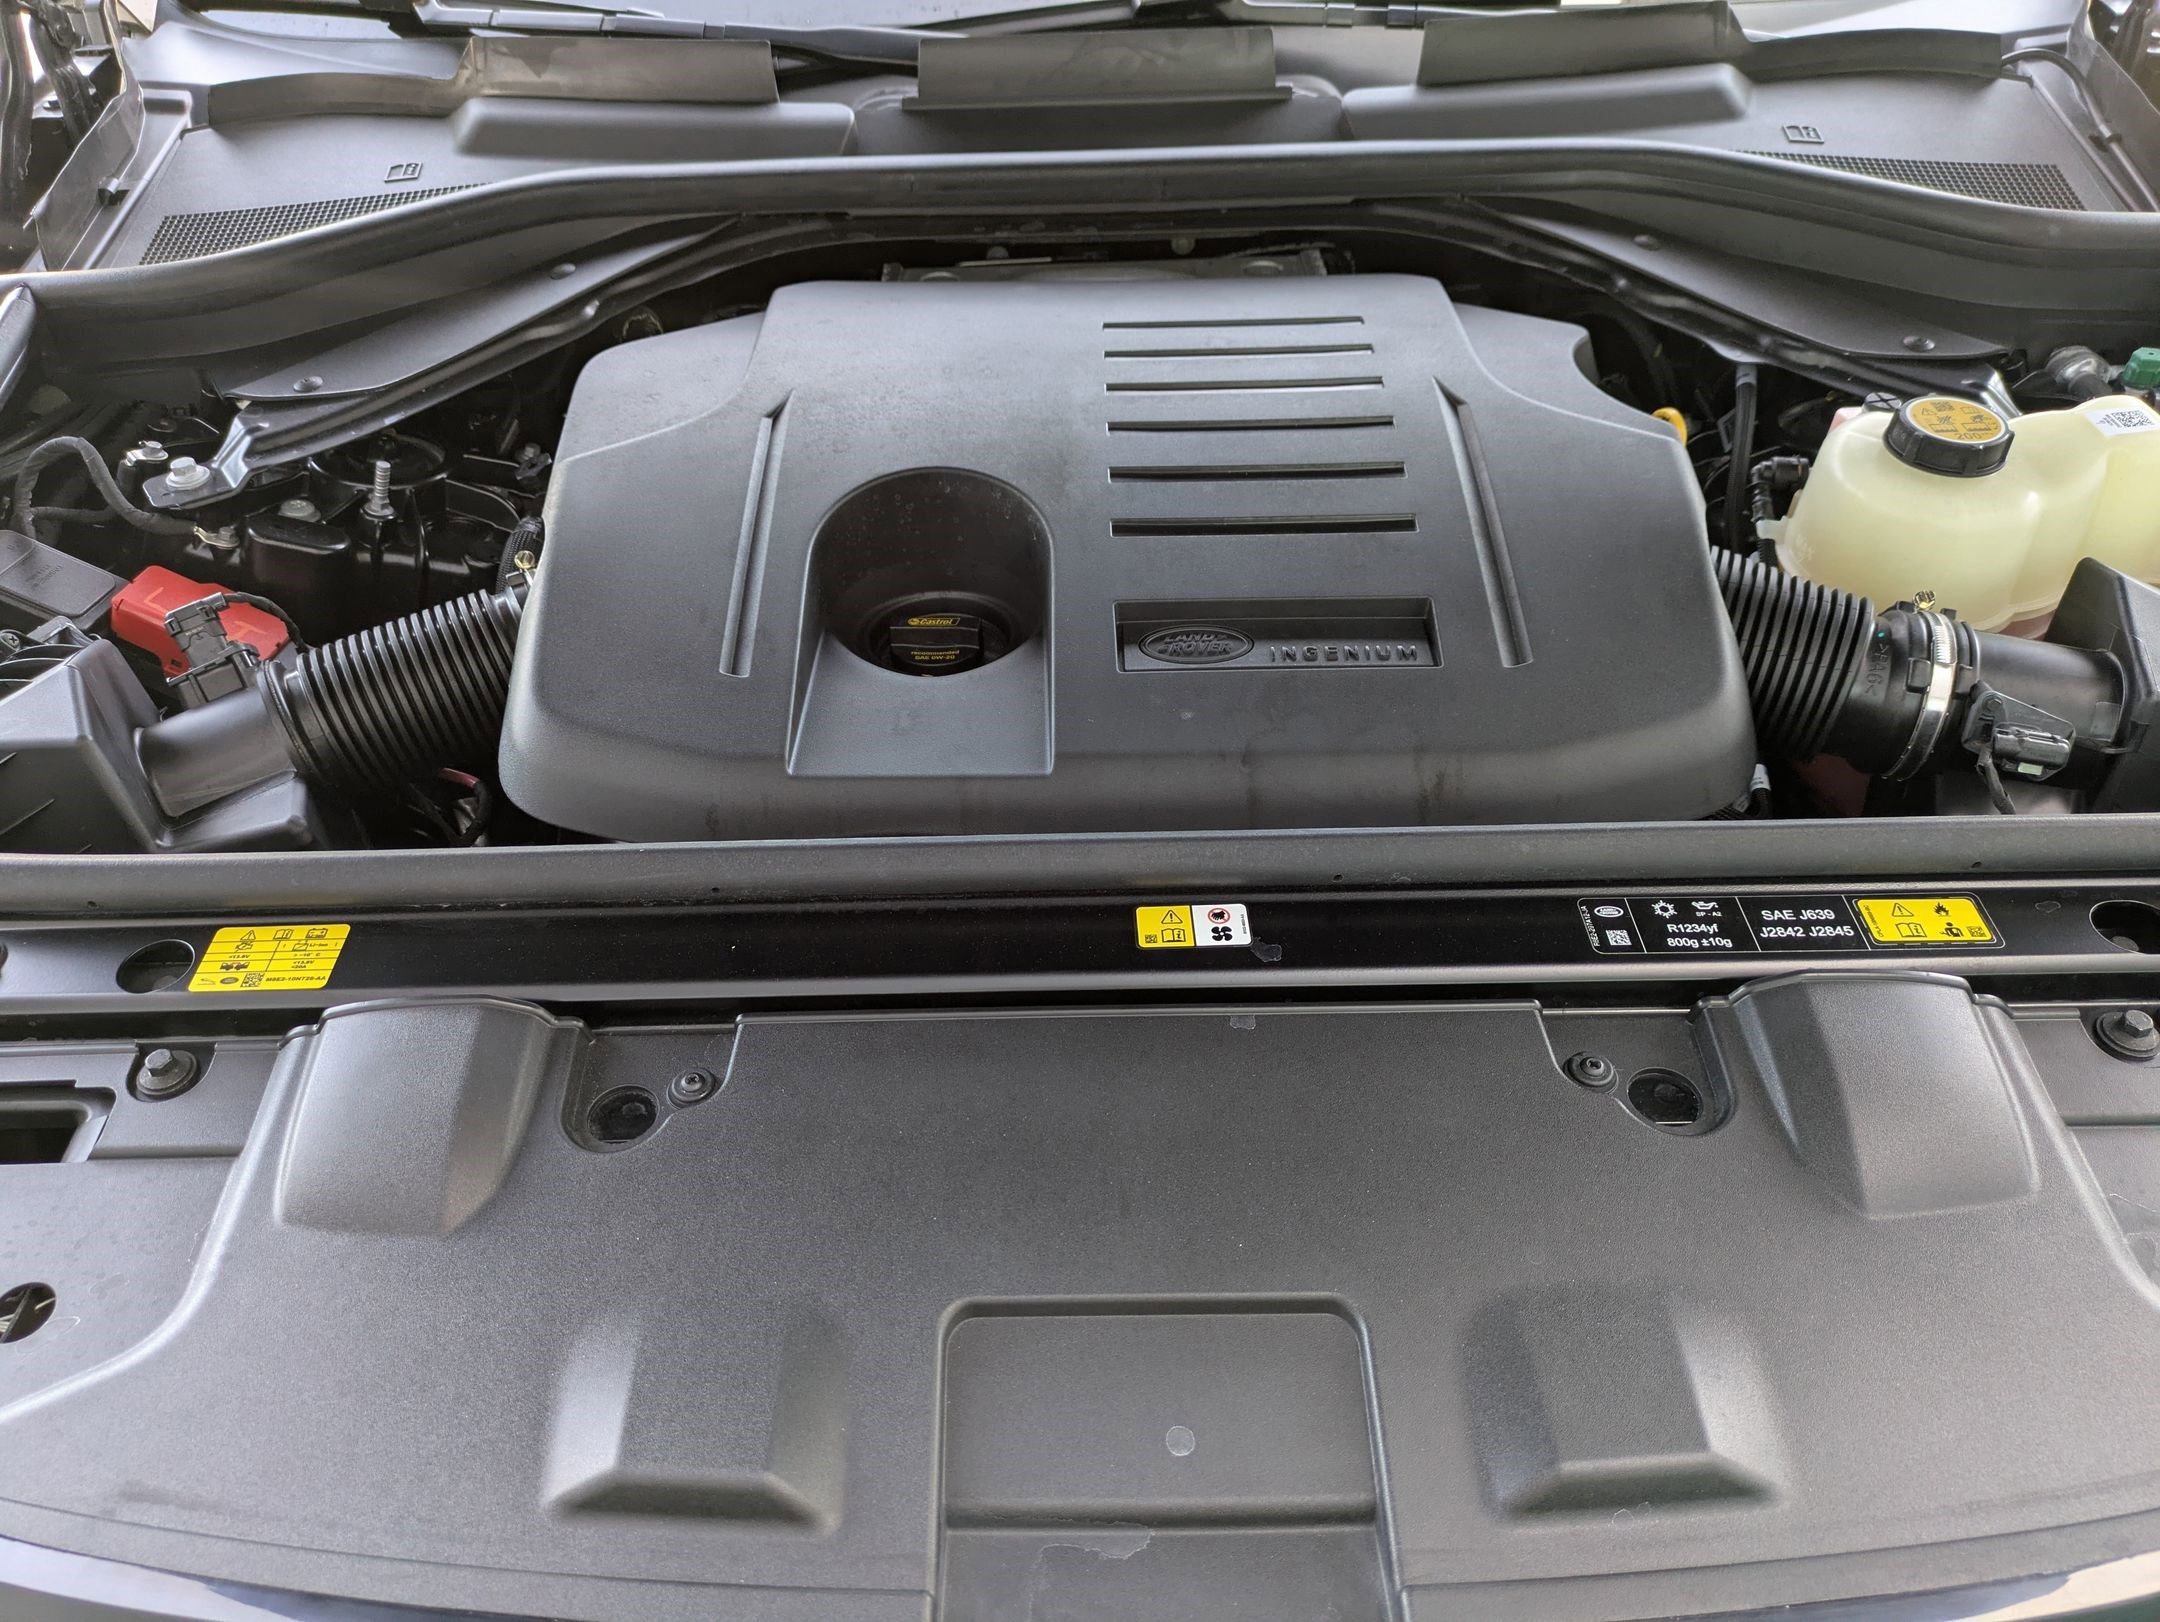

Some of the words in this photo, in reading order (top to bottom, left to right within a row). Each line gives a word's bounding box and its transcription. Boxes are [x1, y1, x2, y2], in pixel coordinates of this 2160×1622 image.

[1164, 632, 1215, 644] LAND
[1168, 640, 1232, 656] ROVER
[1270, 645, 1418, 662] INGENIUM
[1761, 910, 1797, 921] SAE
[1800, 909, 1836, 920] J639
[1667, 923, 1719, 934] R1234yf
[1760, 926, 1806, 938] J2842
[1809, 925, 1855, 937] J2845
[1667, 937, 1700, 948] 800g
[1702, 937, 1733, 948] ±10g
